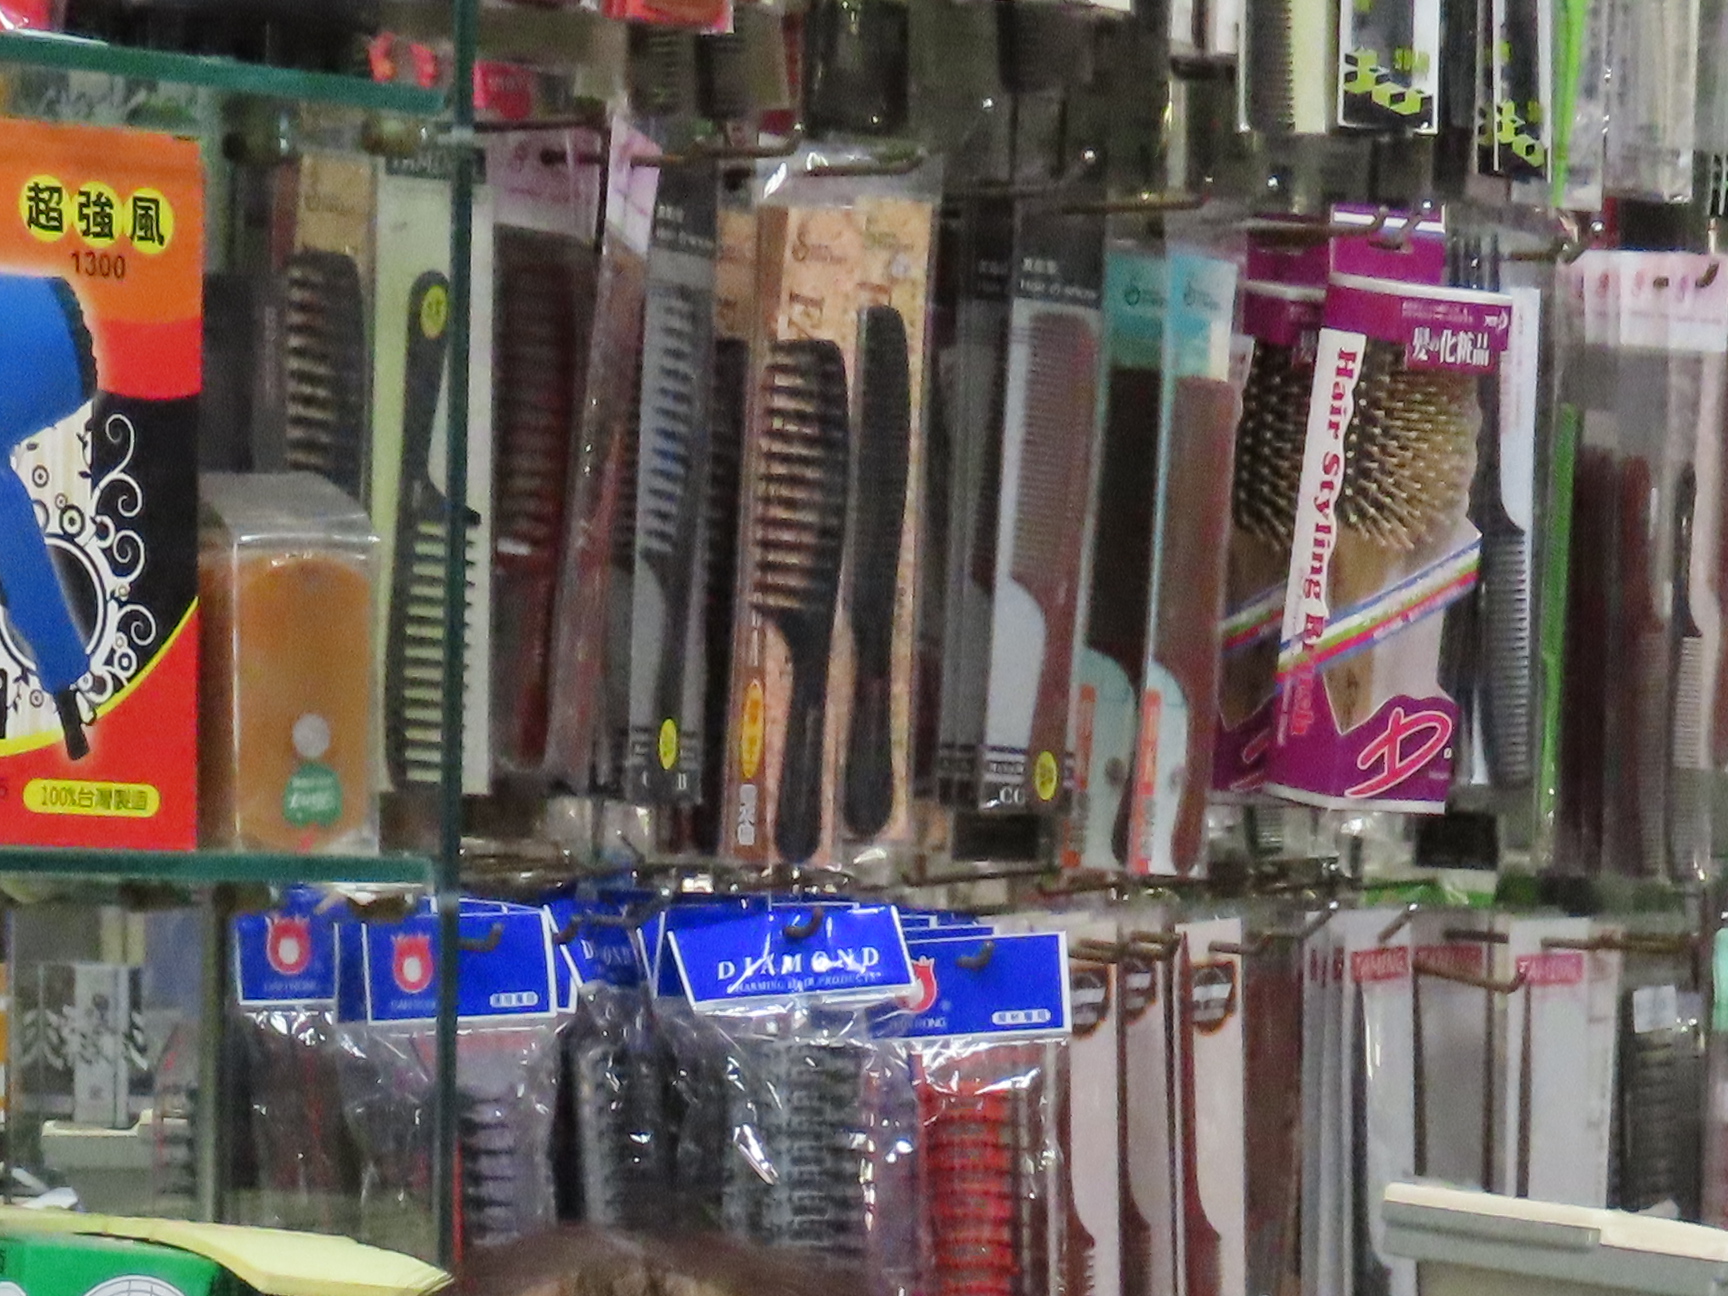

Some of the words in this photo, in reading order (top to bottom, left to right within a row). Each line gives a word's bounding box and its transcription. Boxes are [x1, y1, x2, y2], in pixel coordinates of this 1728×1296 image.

[25, 180, 167, 246] 超強風
[70, 250, 127, 280] 1300
[1327, 348, 1358, 440] Hair
[1303, 451, 1342, 600] Styling
[716, 946, 881, 981] DIAMOND
